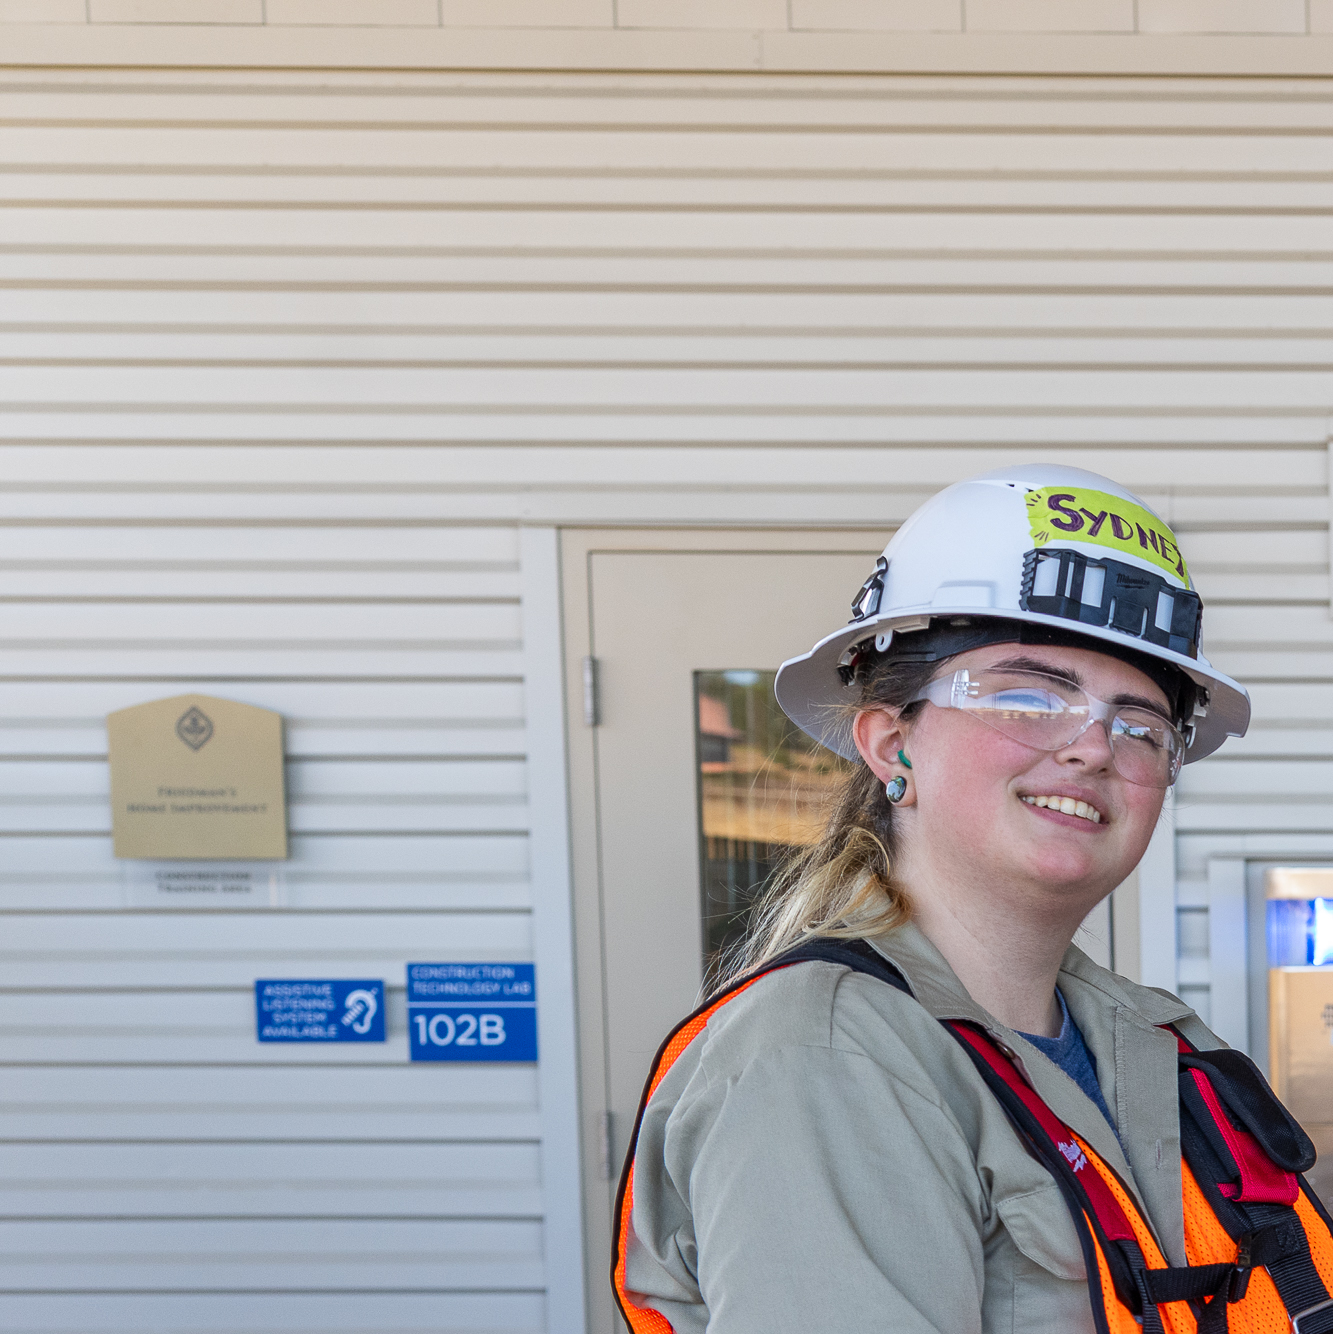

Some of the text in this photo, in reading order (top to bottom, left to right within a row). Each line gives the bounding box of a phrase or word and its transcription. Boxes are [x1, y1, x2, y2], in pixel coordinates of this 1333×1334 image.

[1048, 493, 1184, 578] SYDNEY
[411, 966, 515, 980] CONSTRUCTION
[263, 984, 332, 996] ASSISTIVE
[413, 981, 532, 995] TECHNOLOGY LAB
[262, 998, 335, 1011] LISTENING
[272, 1011, 327, 1023] SYSTEM
[262, 1024, 338, 1038] AVAILABLE
[414, 1014, 506, 1046] 102B
